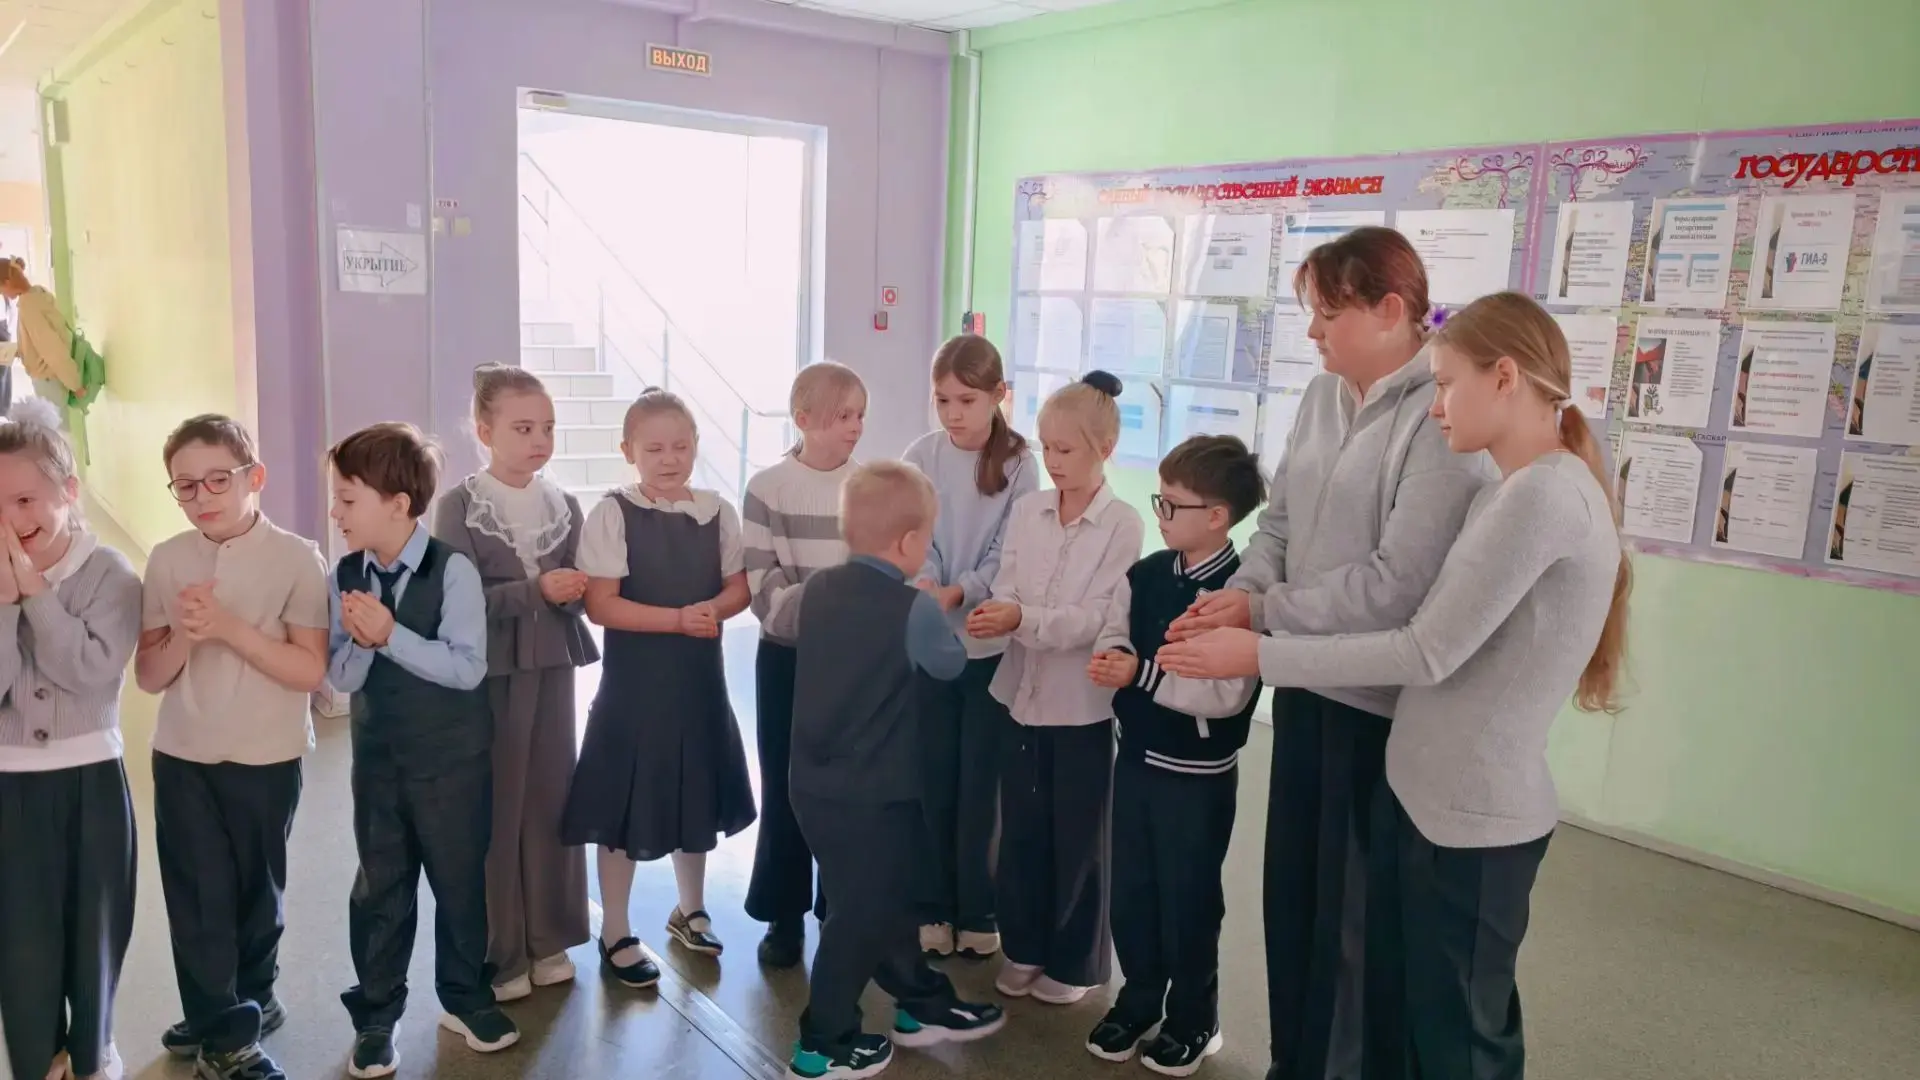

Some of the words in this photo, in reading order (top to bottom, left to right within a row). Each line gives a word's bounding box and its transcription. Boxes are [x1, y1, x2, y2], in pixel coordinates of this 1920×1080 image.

[652, 49, 706, 73] ВЫХОД
[346, 256, 408, 272] УКРЫТИЕ
[1800, 252, 1828, 266] ГИА-9
